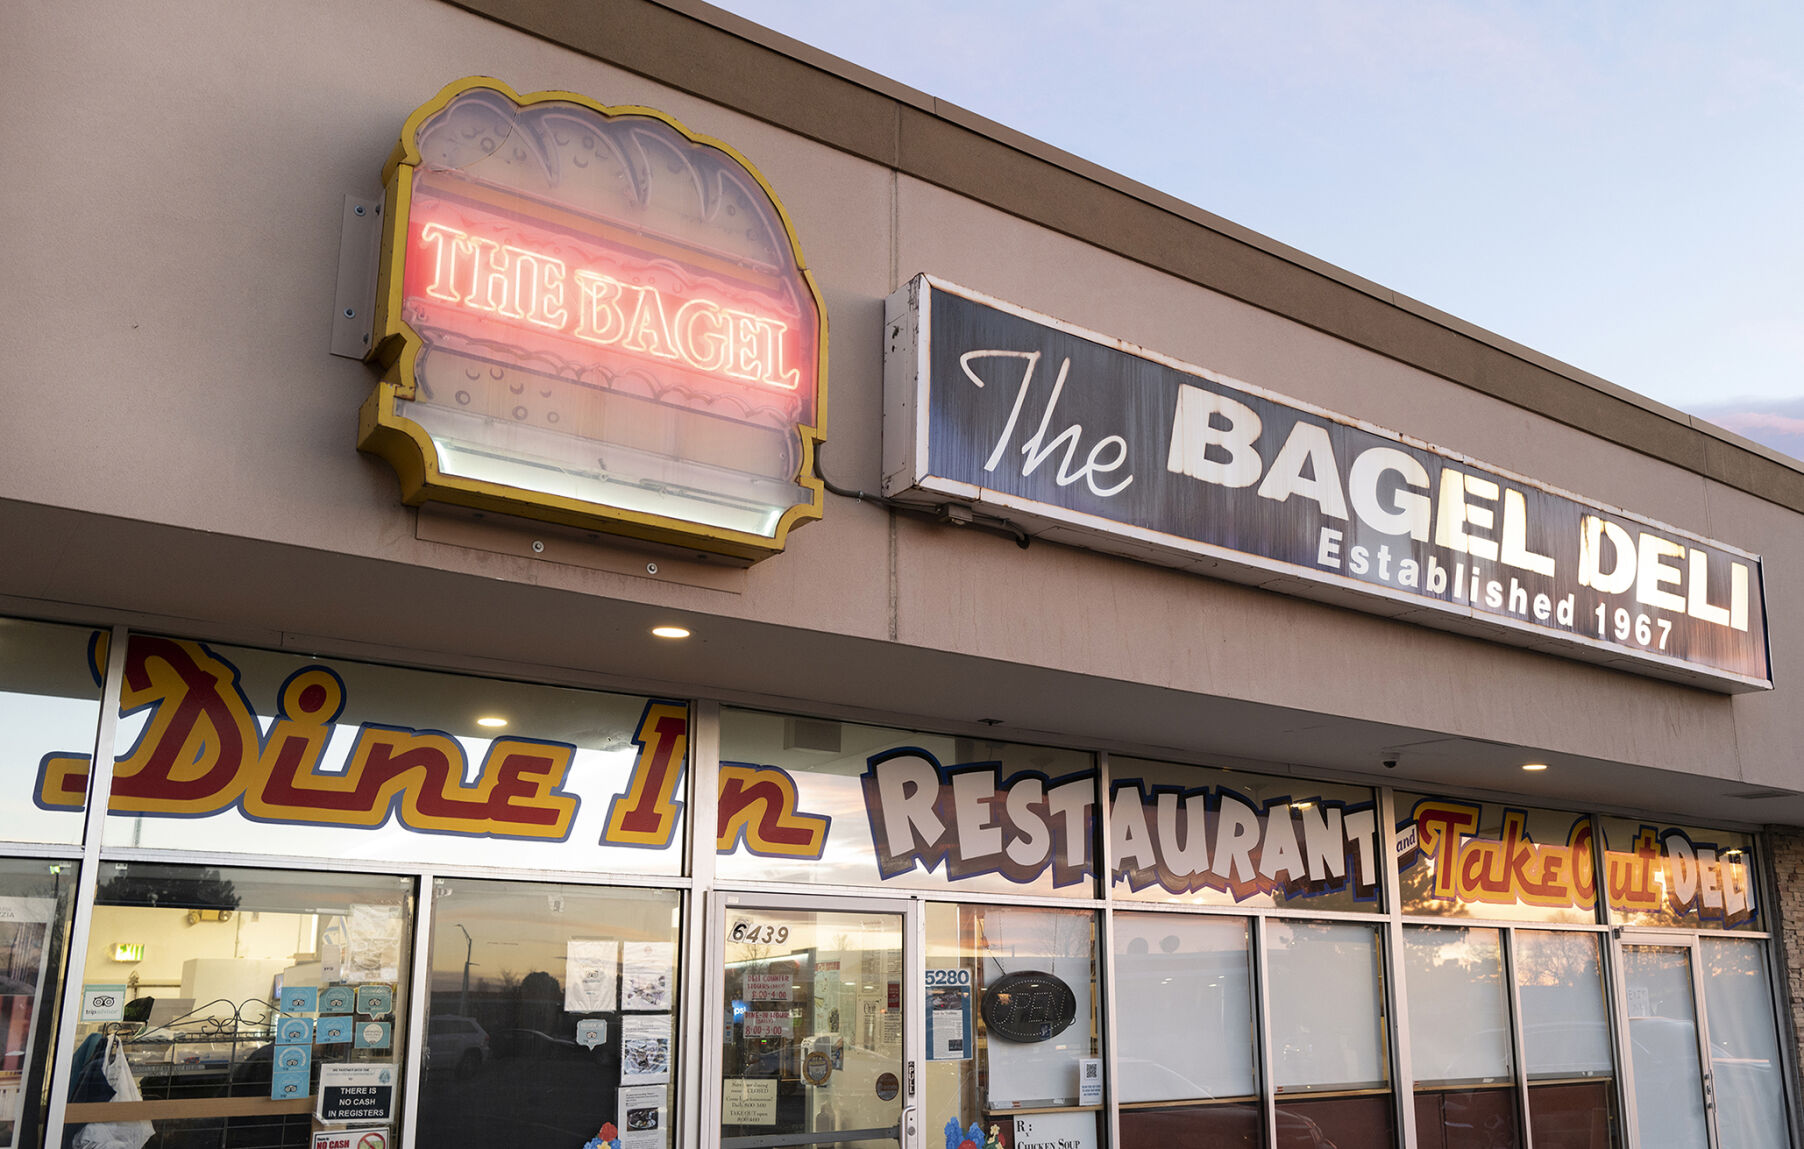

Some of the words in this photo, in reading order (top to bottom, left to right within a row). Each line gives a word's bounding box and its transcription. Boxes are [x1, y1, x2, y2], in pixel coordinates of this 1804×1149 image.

[422, 222, 568, 331] THE
[575, 270, 801, 389] BAGEL
[958, 349, 1135, 498] The
[1166, 382, 1556, 579] BAGEL
[1577, 512, 1750, 633] DELI
[1317, 526, 1576, 629] Established
[1595, 602, 1674, 652] 1967
[34, 630, 581, 843] Dine
[599, 700, 832, 862] In
[861, 746, 1380, 904] RESTAURANT
[1396, 827, 1417, 853] and
[1659, 827, 1760, 930] DELI
[732, 922, 789, 944] 6439
[925, 969, 970, 985] 5280
[992, 992, 1066, 1025] OPEN
[338, 1098, 352, 1106] NO
[353, 1098, 376, 1106] CASH
[340, 1087, 368, 1095] THERE
[368, 1087, 377, 1095] IS
[338, 1109, 384, 1117] REGISTERS
[317, 1141, 328, 1149] NO
[329, 1139, 350, 1149] CASH
[1017, 1141, 1055, 1149] CHICKEN
[1058, 1138, 1081, 1149] SOUP
